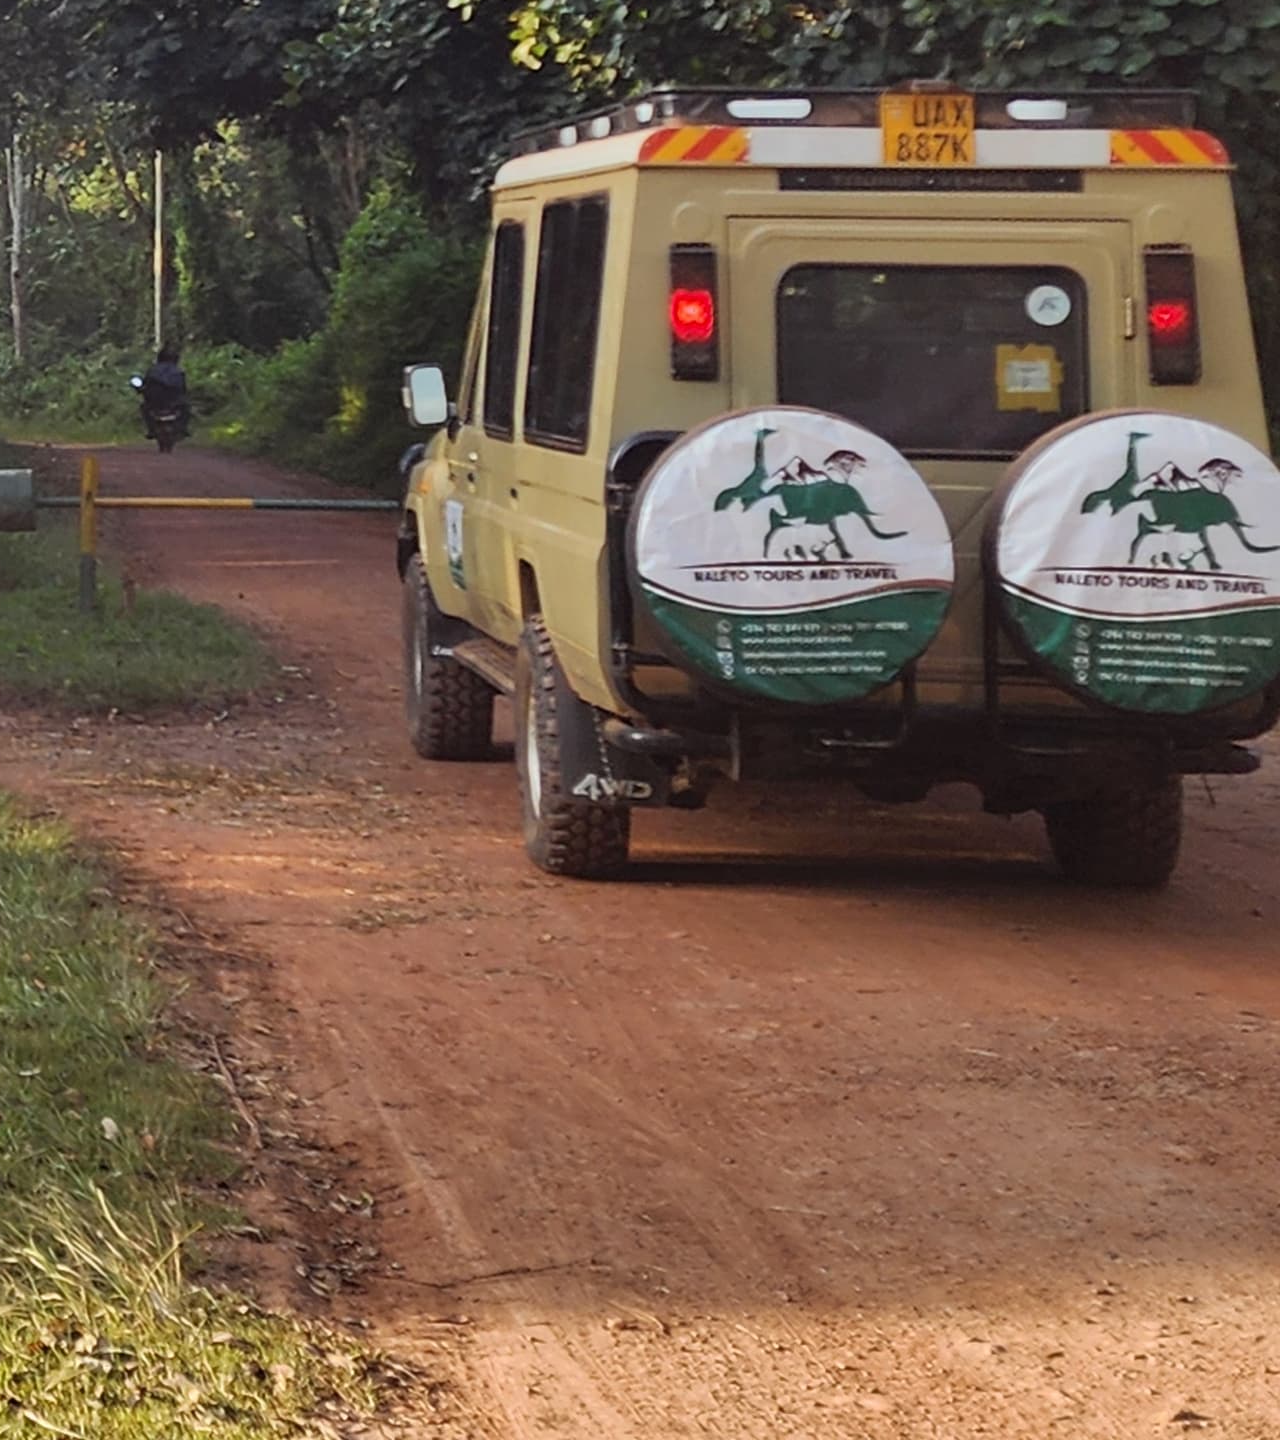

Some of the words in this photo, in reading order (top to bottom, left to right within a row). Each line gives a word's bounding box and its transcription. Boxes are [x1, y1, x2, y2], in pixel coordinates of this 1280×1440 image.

[912, 98, 969, 128] UAX
[895, 132, 969, 162] 887K
[754, 569, 804, 581] TOURS
[809, 568, 840, 581] AND
[844, 567, 898, 580] TRAVEL
[1118, 575, 1170, 589] TOURS
[1175, 578, 1208, 591] AND
[1212, 580, 1268, 594] TRAVEL
[572, 773, 653, 801] 4WD
